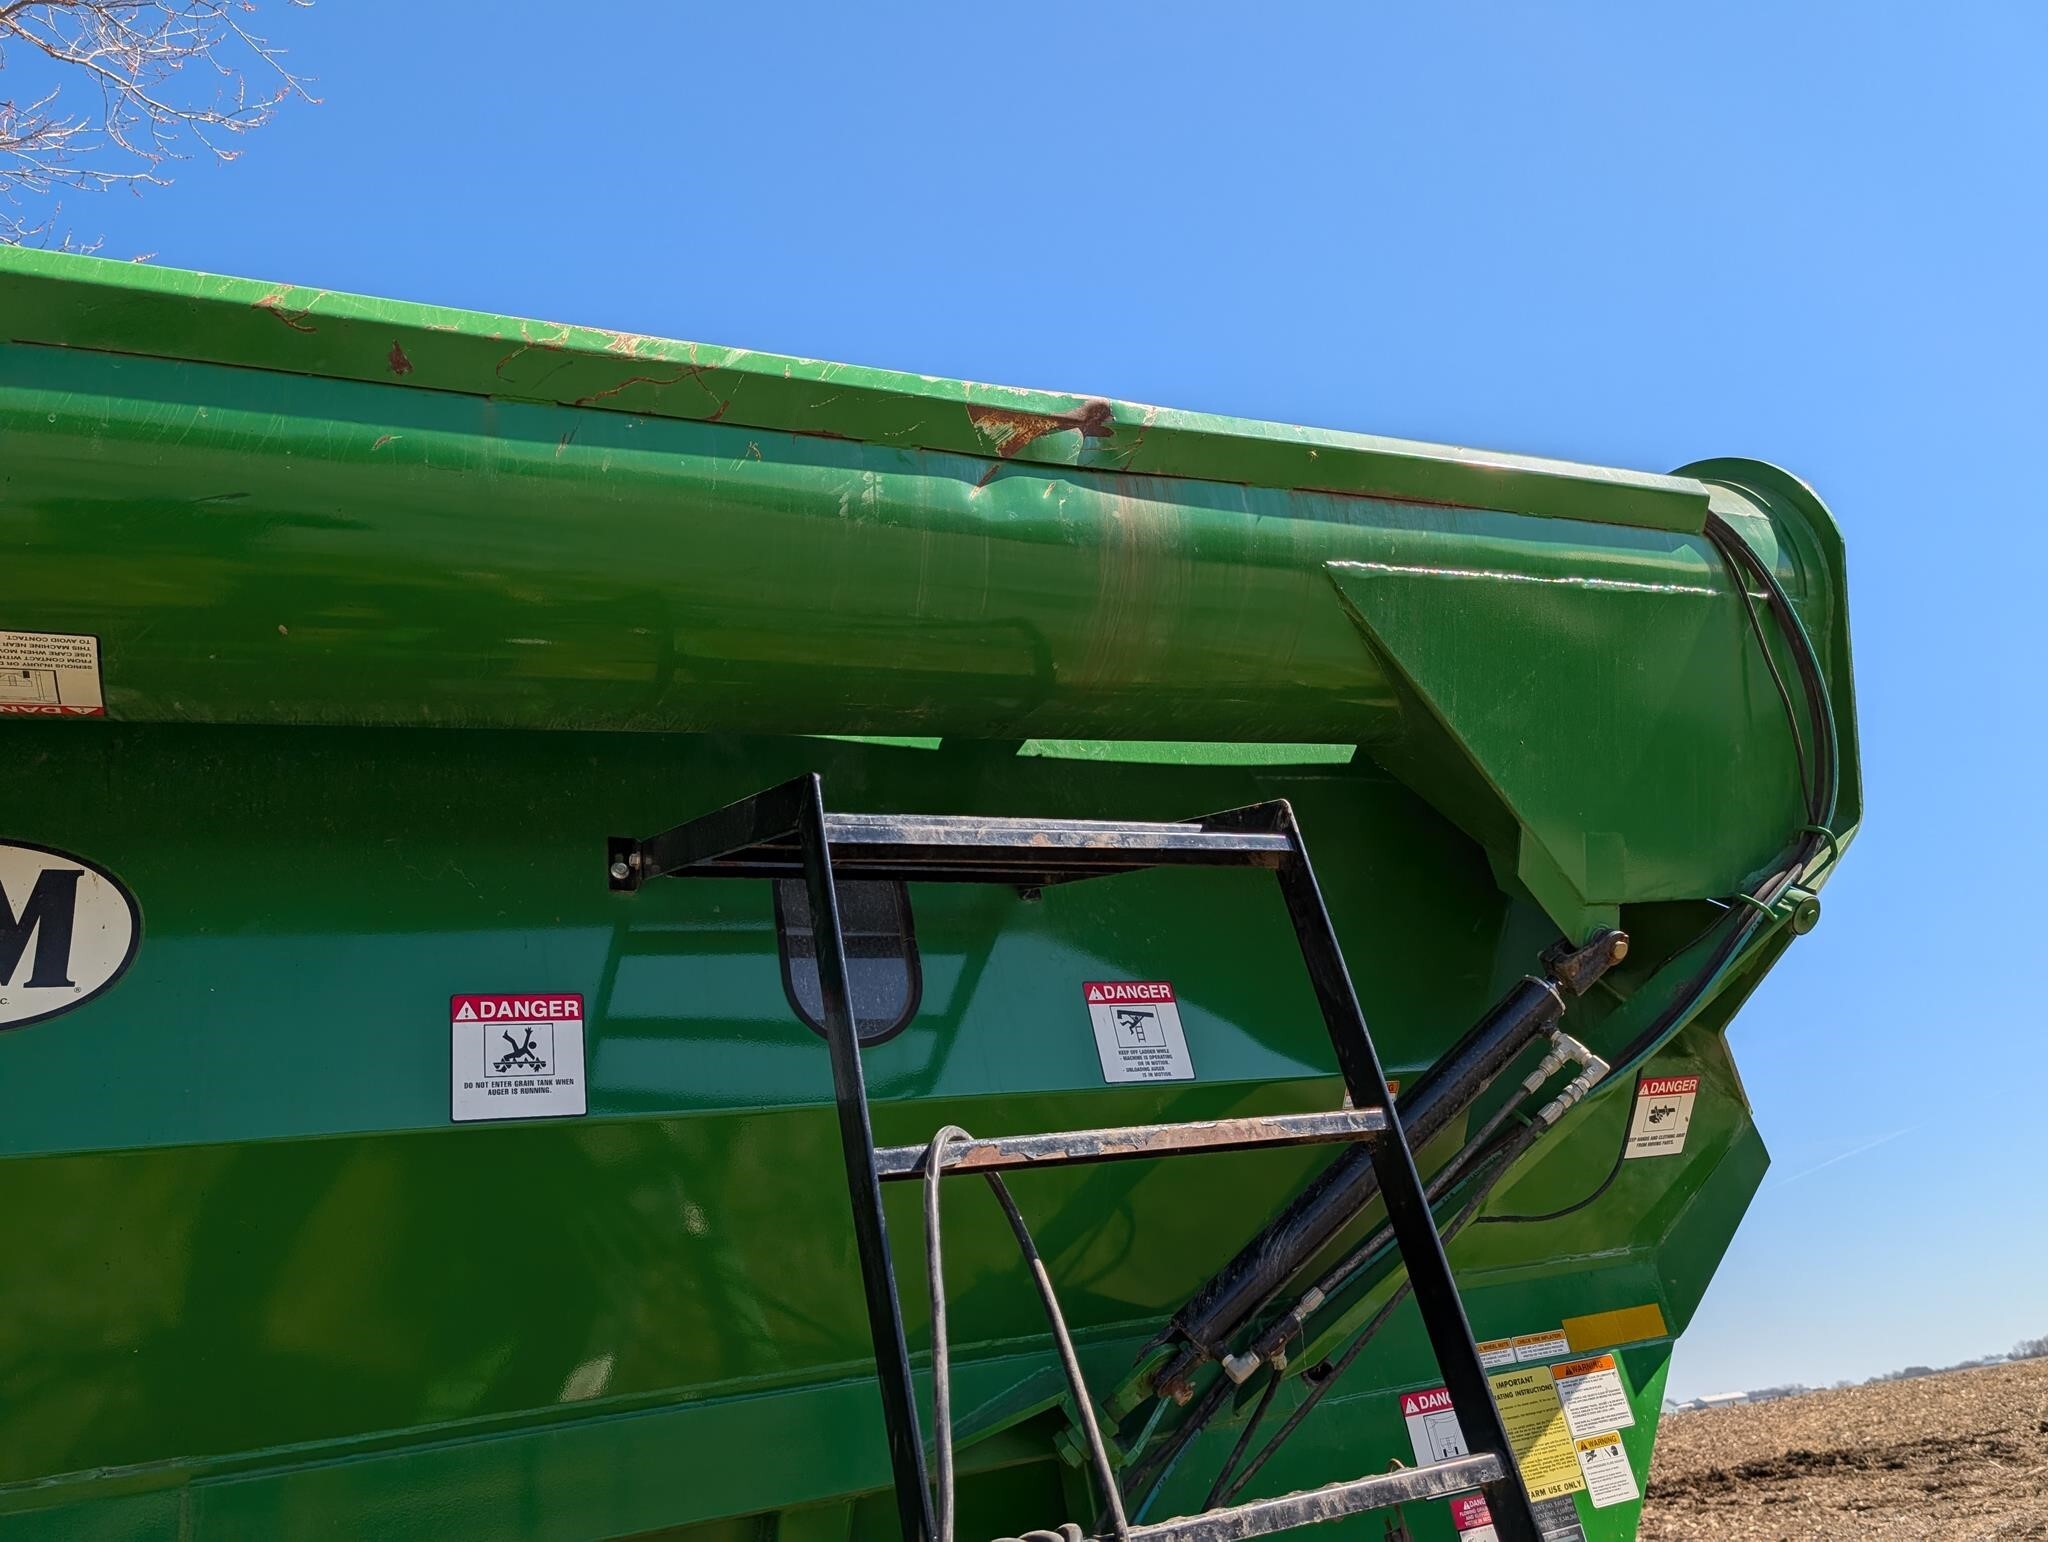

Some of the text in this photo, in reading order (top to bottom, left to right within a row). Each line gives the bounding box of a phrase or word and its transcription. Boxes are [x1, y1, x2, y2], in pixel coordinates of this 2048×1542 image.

[1103, 985, 1171, 999] DANGER
[480, 1000, 579, 1018] DANGER
[475, 1081, 489, 1089] NOT
[491, 1080, 512, 1088] ENTER
[514, 1079, 535, 1087] GRAIN
[556, 1078, 574, 1086] WHEN
[1650, 1079, 1698, 1094] DANGER
[488, 1088, 509, 1096] AUGER
[520, 1087, 552, 1095] RUNNING.
[1571, 1361, 1604, 1373] WARNING
[1496, 1376, 1534, 1389] IMPORTANT
[1514, 1384, 1554, 1397] INSTRUCTIONS
[1588, 1436, 1618, 1448] WARNING
[1529, 1480, 1582, 1498] ARM USE ONLY
